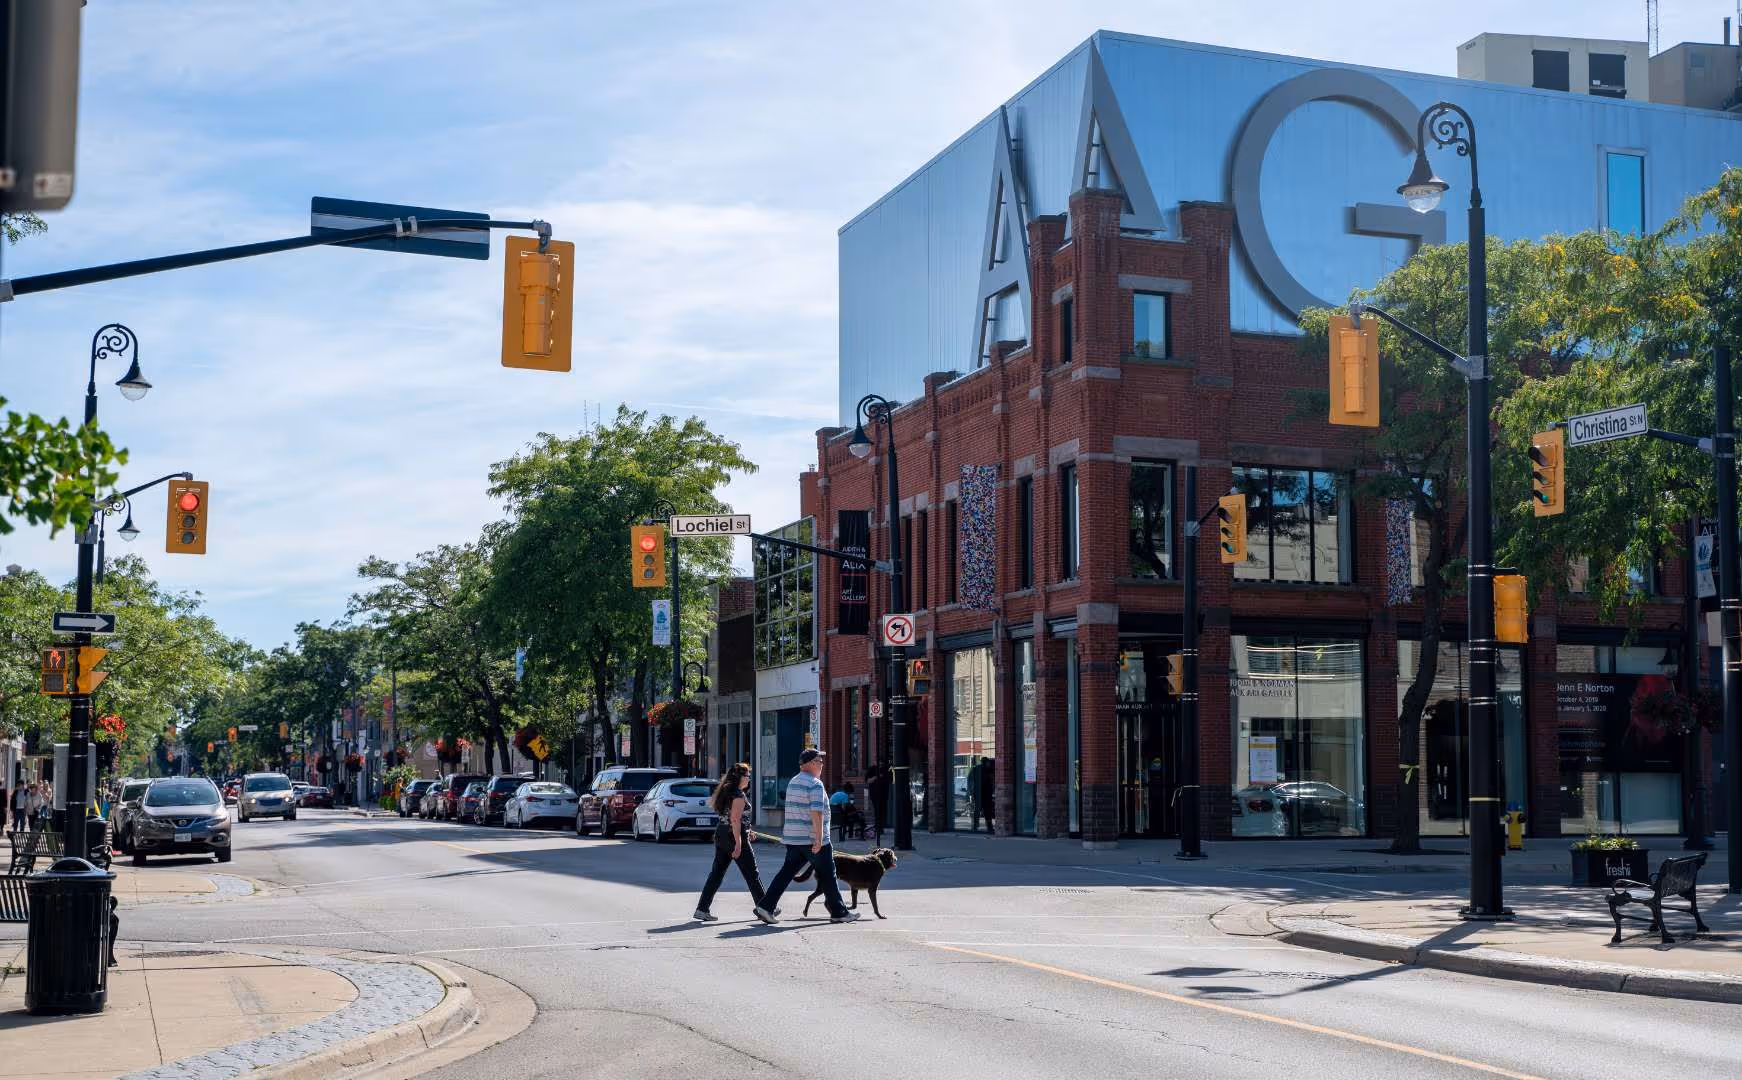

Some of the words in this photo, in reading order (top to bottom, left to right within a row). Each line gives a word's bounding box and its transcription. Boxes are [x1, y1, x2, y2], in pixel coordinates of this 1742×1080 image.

[1574, 416, 1627, 440] Christina
[676, 518, 733, 532] Lochiel
[736, 520, 745, 529] St
[1262, 680, 1295, 688] NORMAN
[1556, 683, 1575, 692] Jenn
[1577, 683, 1583, 692] E
[1585, 684, 1614, 693] Norton
[1563, 705, 1585, 713] January
